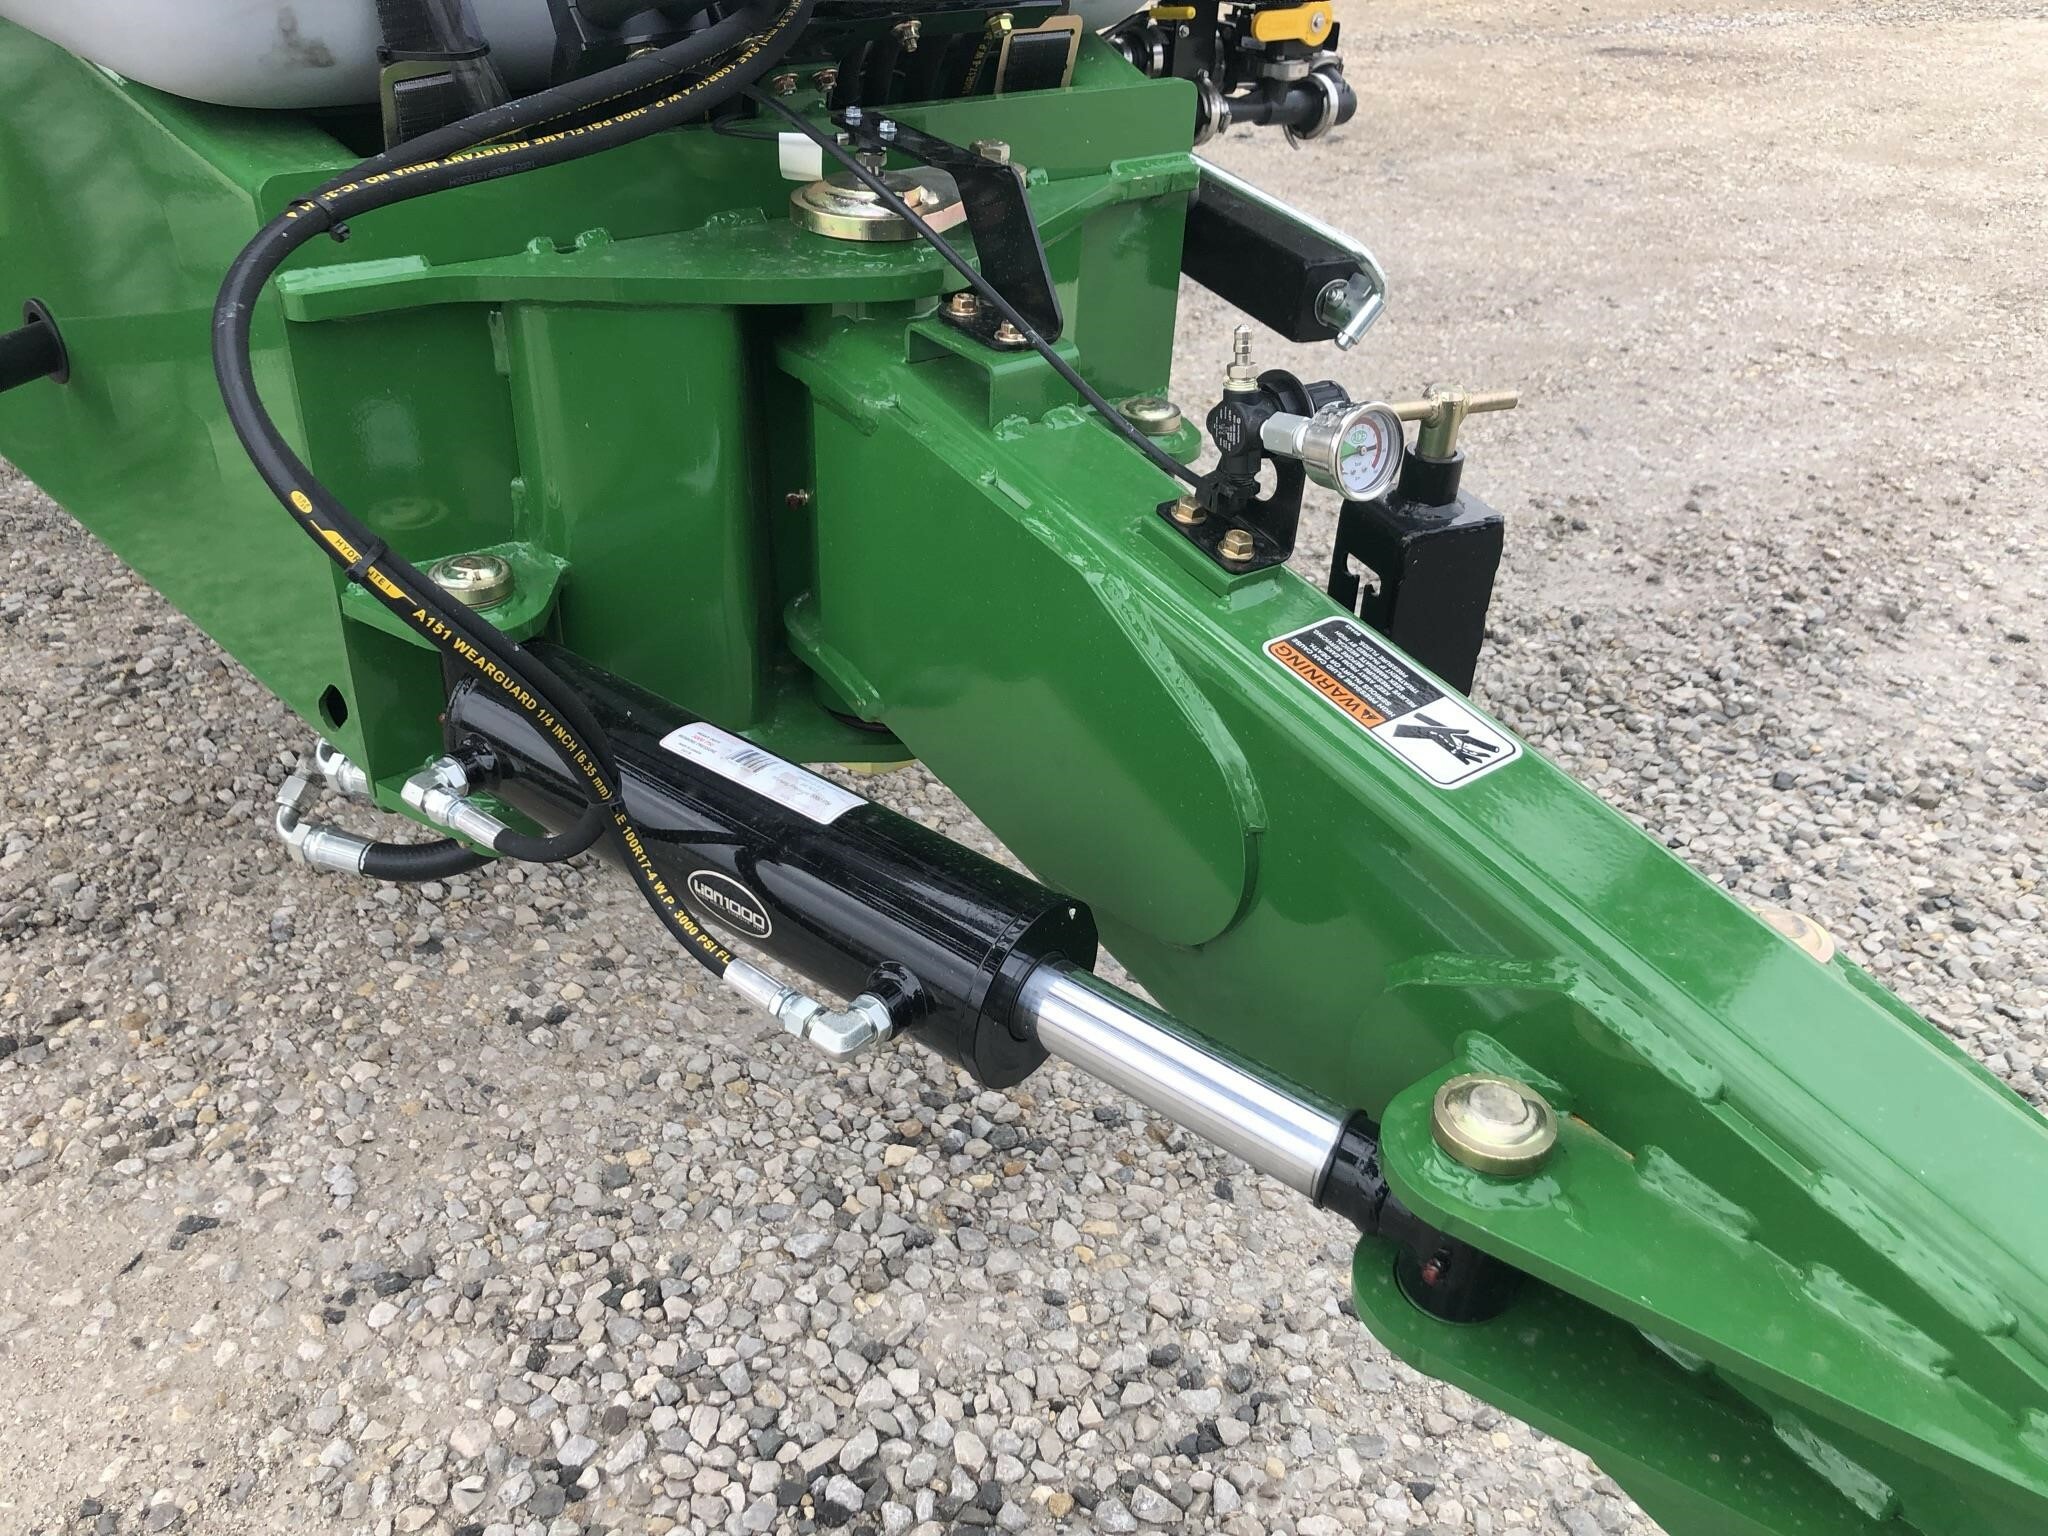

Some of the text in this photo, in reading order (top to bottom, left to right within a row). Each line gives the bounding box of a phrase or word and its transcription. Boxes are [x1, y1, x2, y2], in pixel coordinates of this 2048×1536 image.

[615, 107, 648, 123] 3000
[587, 119, 613, 132] PSI
[534, 127, 585, 146] FLAME
[443, 141, 530, 165] RESISTANT
[392, 160, 440, 176] MSHA
[1340, 651, 1365, 667] BEFORE
[1355, 646, 1381, 664] INJURED
[1340, 659, 1360, 672] FROM
[1357, 656, 1390, 679] IMMEDIATE
[1376, 655, 1409, 677] PRESSURE
[1274, 645, 1361, 711] WARNING
[1291, 638, 1396, 717] HIGH PRESSURE FLUID CAN CAUSE
[1338, 666, 1364, 684] INJURY
[1361, 667, 1394, 689] PRESSURE
[1384, 668, 1419, 693] TREATMENT
[1387, 678, 1405, 690] SEEK
[1361, 684, 1392, 705] SERIOUS
[1372, 683, 1391, 695] KEEP
[1391, 689, 1417, 707] RELIEVE
[412, 608, 452, 640] A151
[453, 637, 537, 710] WEARGUARD
[537, 709, 554, 726] 1/4
[552, 723, 578, 752] INCH
[573, 749, 595, 777] (6.35
[592, 776, 613, 800] mm)
[622, 826, 658, 881] 100R17-4
[654, 881, 675, 909] W.P.
[673, 910, 698, 935] 3000
[696, 934, 718, 953] PSI
